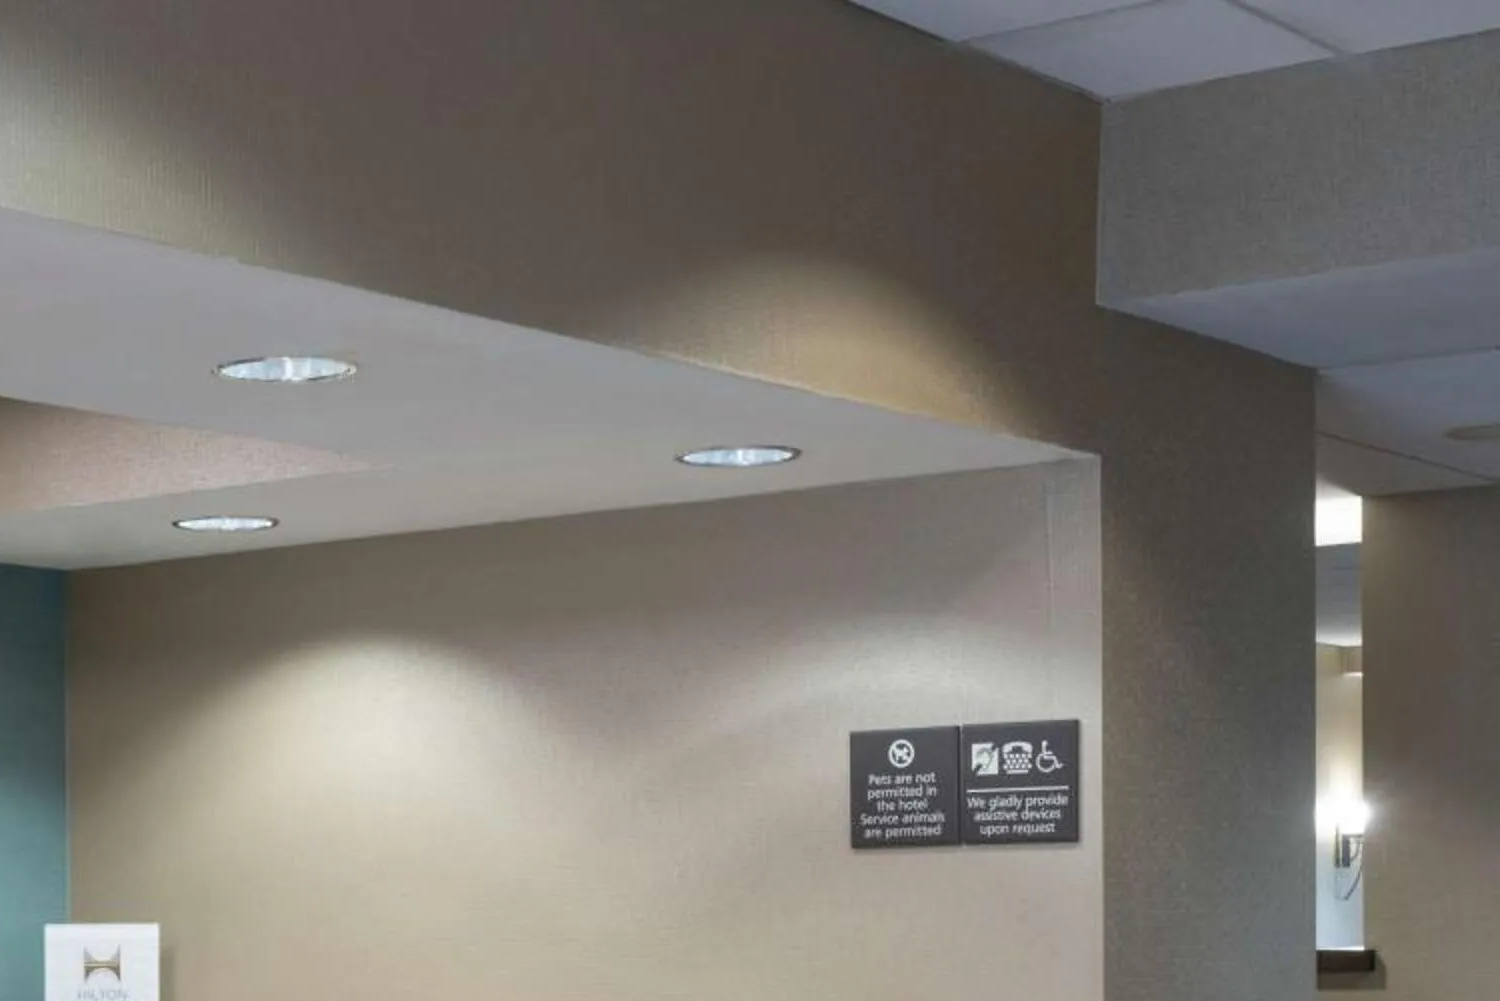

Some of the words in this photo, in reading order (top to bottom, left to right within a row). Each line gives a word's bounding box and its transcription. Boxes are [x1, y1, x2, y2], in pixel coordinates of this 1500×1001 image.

[895, 775, 912, 784] are
[916, 772, 936, 783] not
[867, 785, 922, 800] permitted
[926, 785, 937, 797] in
[877, 799, 895, 812] the
[967, 797, 986, 808] We
[988, 795, 1022, 811] gladly
[1026, 793, 1068, 812] provide
[861, 812, 898, 825] Service
[1021, 807, 1060, 821] devices
[864, 828, 881, 838] are
[980, 824, 1008, 837] upon
[1012, 823, 1054, 836] request
